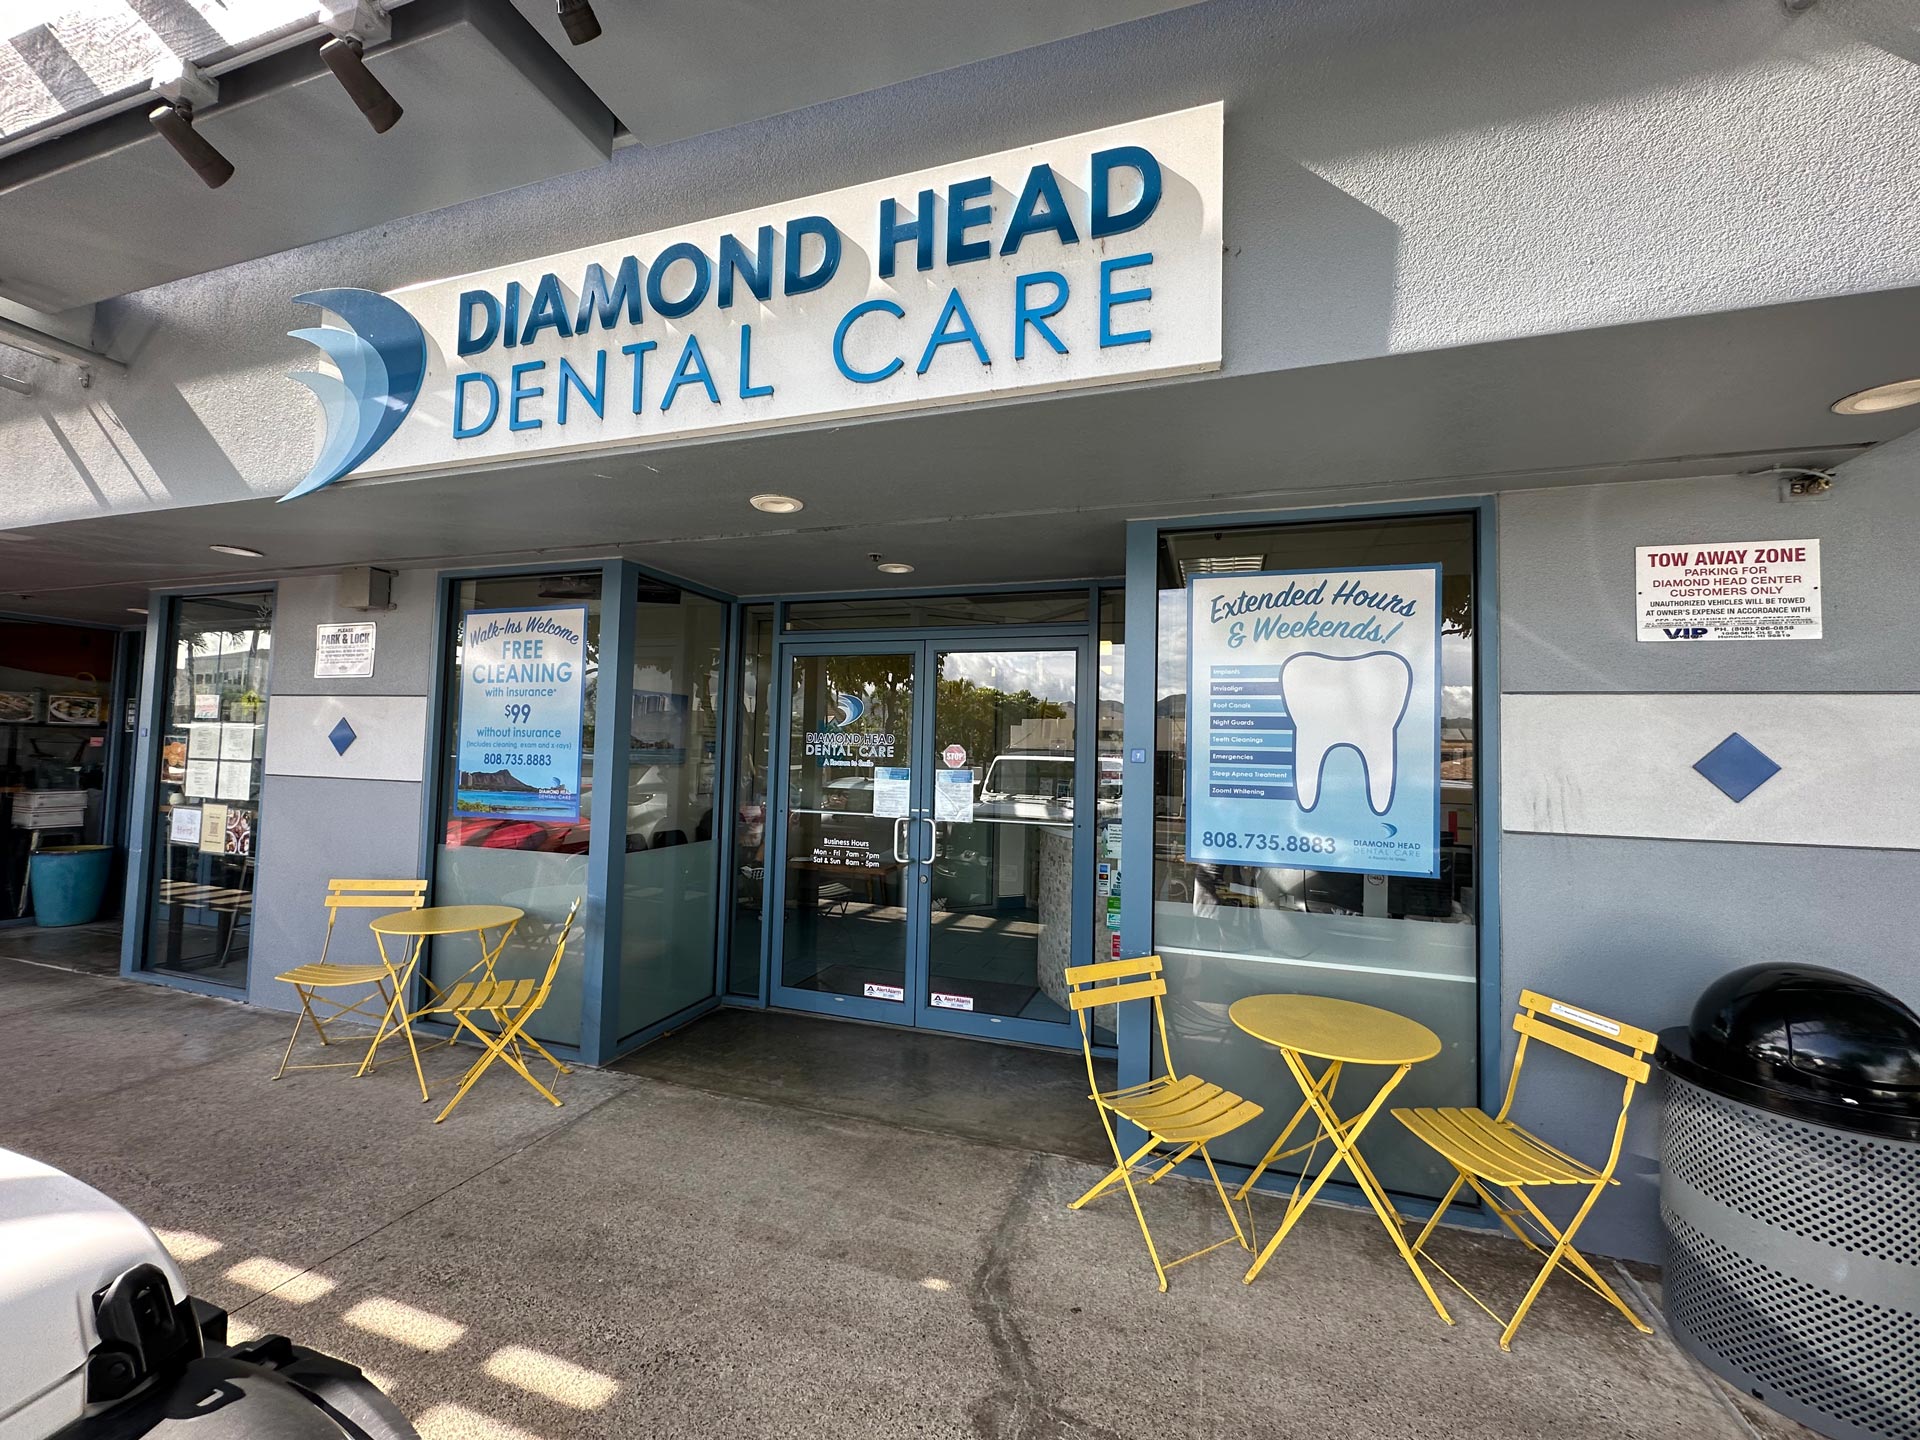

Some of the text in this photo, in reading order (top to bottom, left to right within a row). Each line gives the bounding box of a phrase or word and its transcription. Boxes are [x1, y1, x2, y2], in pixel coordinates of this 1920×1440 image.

[457, 145, 1162, 356] DIAMOND HEAD
[453, 253, 1154, 439] DENTAL CARE
[1648, 547, 1807, 567] TOW AWAY ZONE
[1684, 566, 1767, 577] PARKING FOR
[1652, 575, 1802, 588] DIAMOND HEAD CENTER
[1670, 586, 1783, 597] CUSTOMERS ONLY
[1210, 579, 1417, 624] Extended Hours
[1650, 599, 1706, 607] UNAUTHORIZED
[1707, 598, 1743, 606] VEHICLES
[1765, 597, 1776, 605] BE
[1656, 608, 1691, 616] OWNER'S
[1692, 607, 1725, 615] EXPENSE
[1736, 606, 1789, 614] ACCORDANCE
[470, 616, 580, 648] Walk-Ins Welcome
[1227, 610, 1404, 649] & Weekends!
[1663, 628, 1708, 639] VIP
[321, 633, 370, 644] PARK & LOCK
[502, 639, 544, 660] FREE
[472, 662, 573, 684] CLEANING
[485, 687, 504, 697] with
[504, 703, 531, 724] $99
[1212, 719, 1230, 727] Night
[476, 727, 562, 738] without insurance
[805, 732, 896, 745] DIAMOND HEAD
[1230, 736, 1263, 744] Cleanings
[805, 744, 895, 757] DENTAL CARE
[483, 753, 552, 766] 808.735.8883
[947, 752, 963, 761] STOP
[1233, 788, 1265, 796] Whitening
[823, 837, 850, 846] Business
[1202, 831, 1337, 854] 808.735.8883
[1353, 839, 1421, 850] DIAMOND HEAD
[813, 848, 827, 856] Mon
[845, 850, 860, 858] 7am
[865, 851, 880, 860] 7pm
[1393, 848, 1421, 858] CARE
[829, 857, 841, 865] Sun
[865, 860, 880, 868] 5pm
